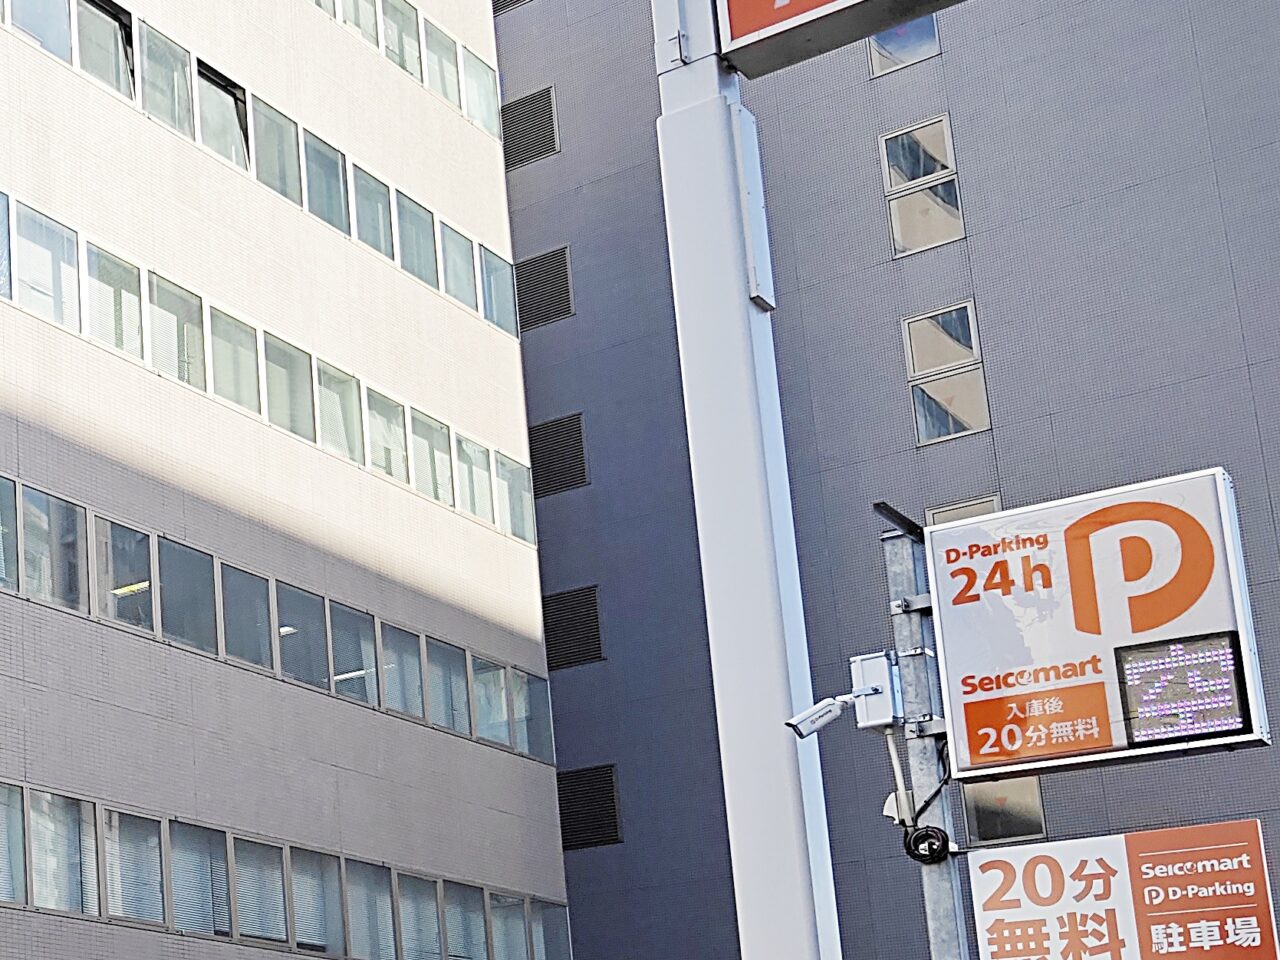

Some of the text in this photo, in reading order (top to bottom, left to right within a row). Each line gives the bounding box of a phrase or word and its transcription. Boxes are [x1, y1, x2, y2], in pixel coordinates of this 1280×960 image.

[945, 533, 1048, 564] D-Parking
[960, 654, 1102, 695] Seicomart
[1006, 696, 1064, 721] 入庫後
[977, 716, 1100, 756] 20分無料
[978, 854, 1118, 912] 20分
[1140, 853, 1251, 879] Seicomart
[1167, 881, 1255, 901] D-Parking
[1150, 916, 1261, 954] 駐車場
